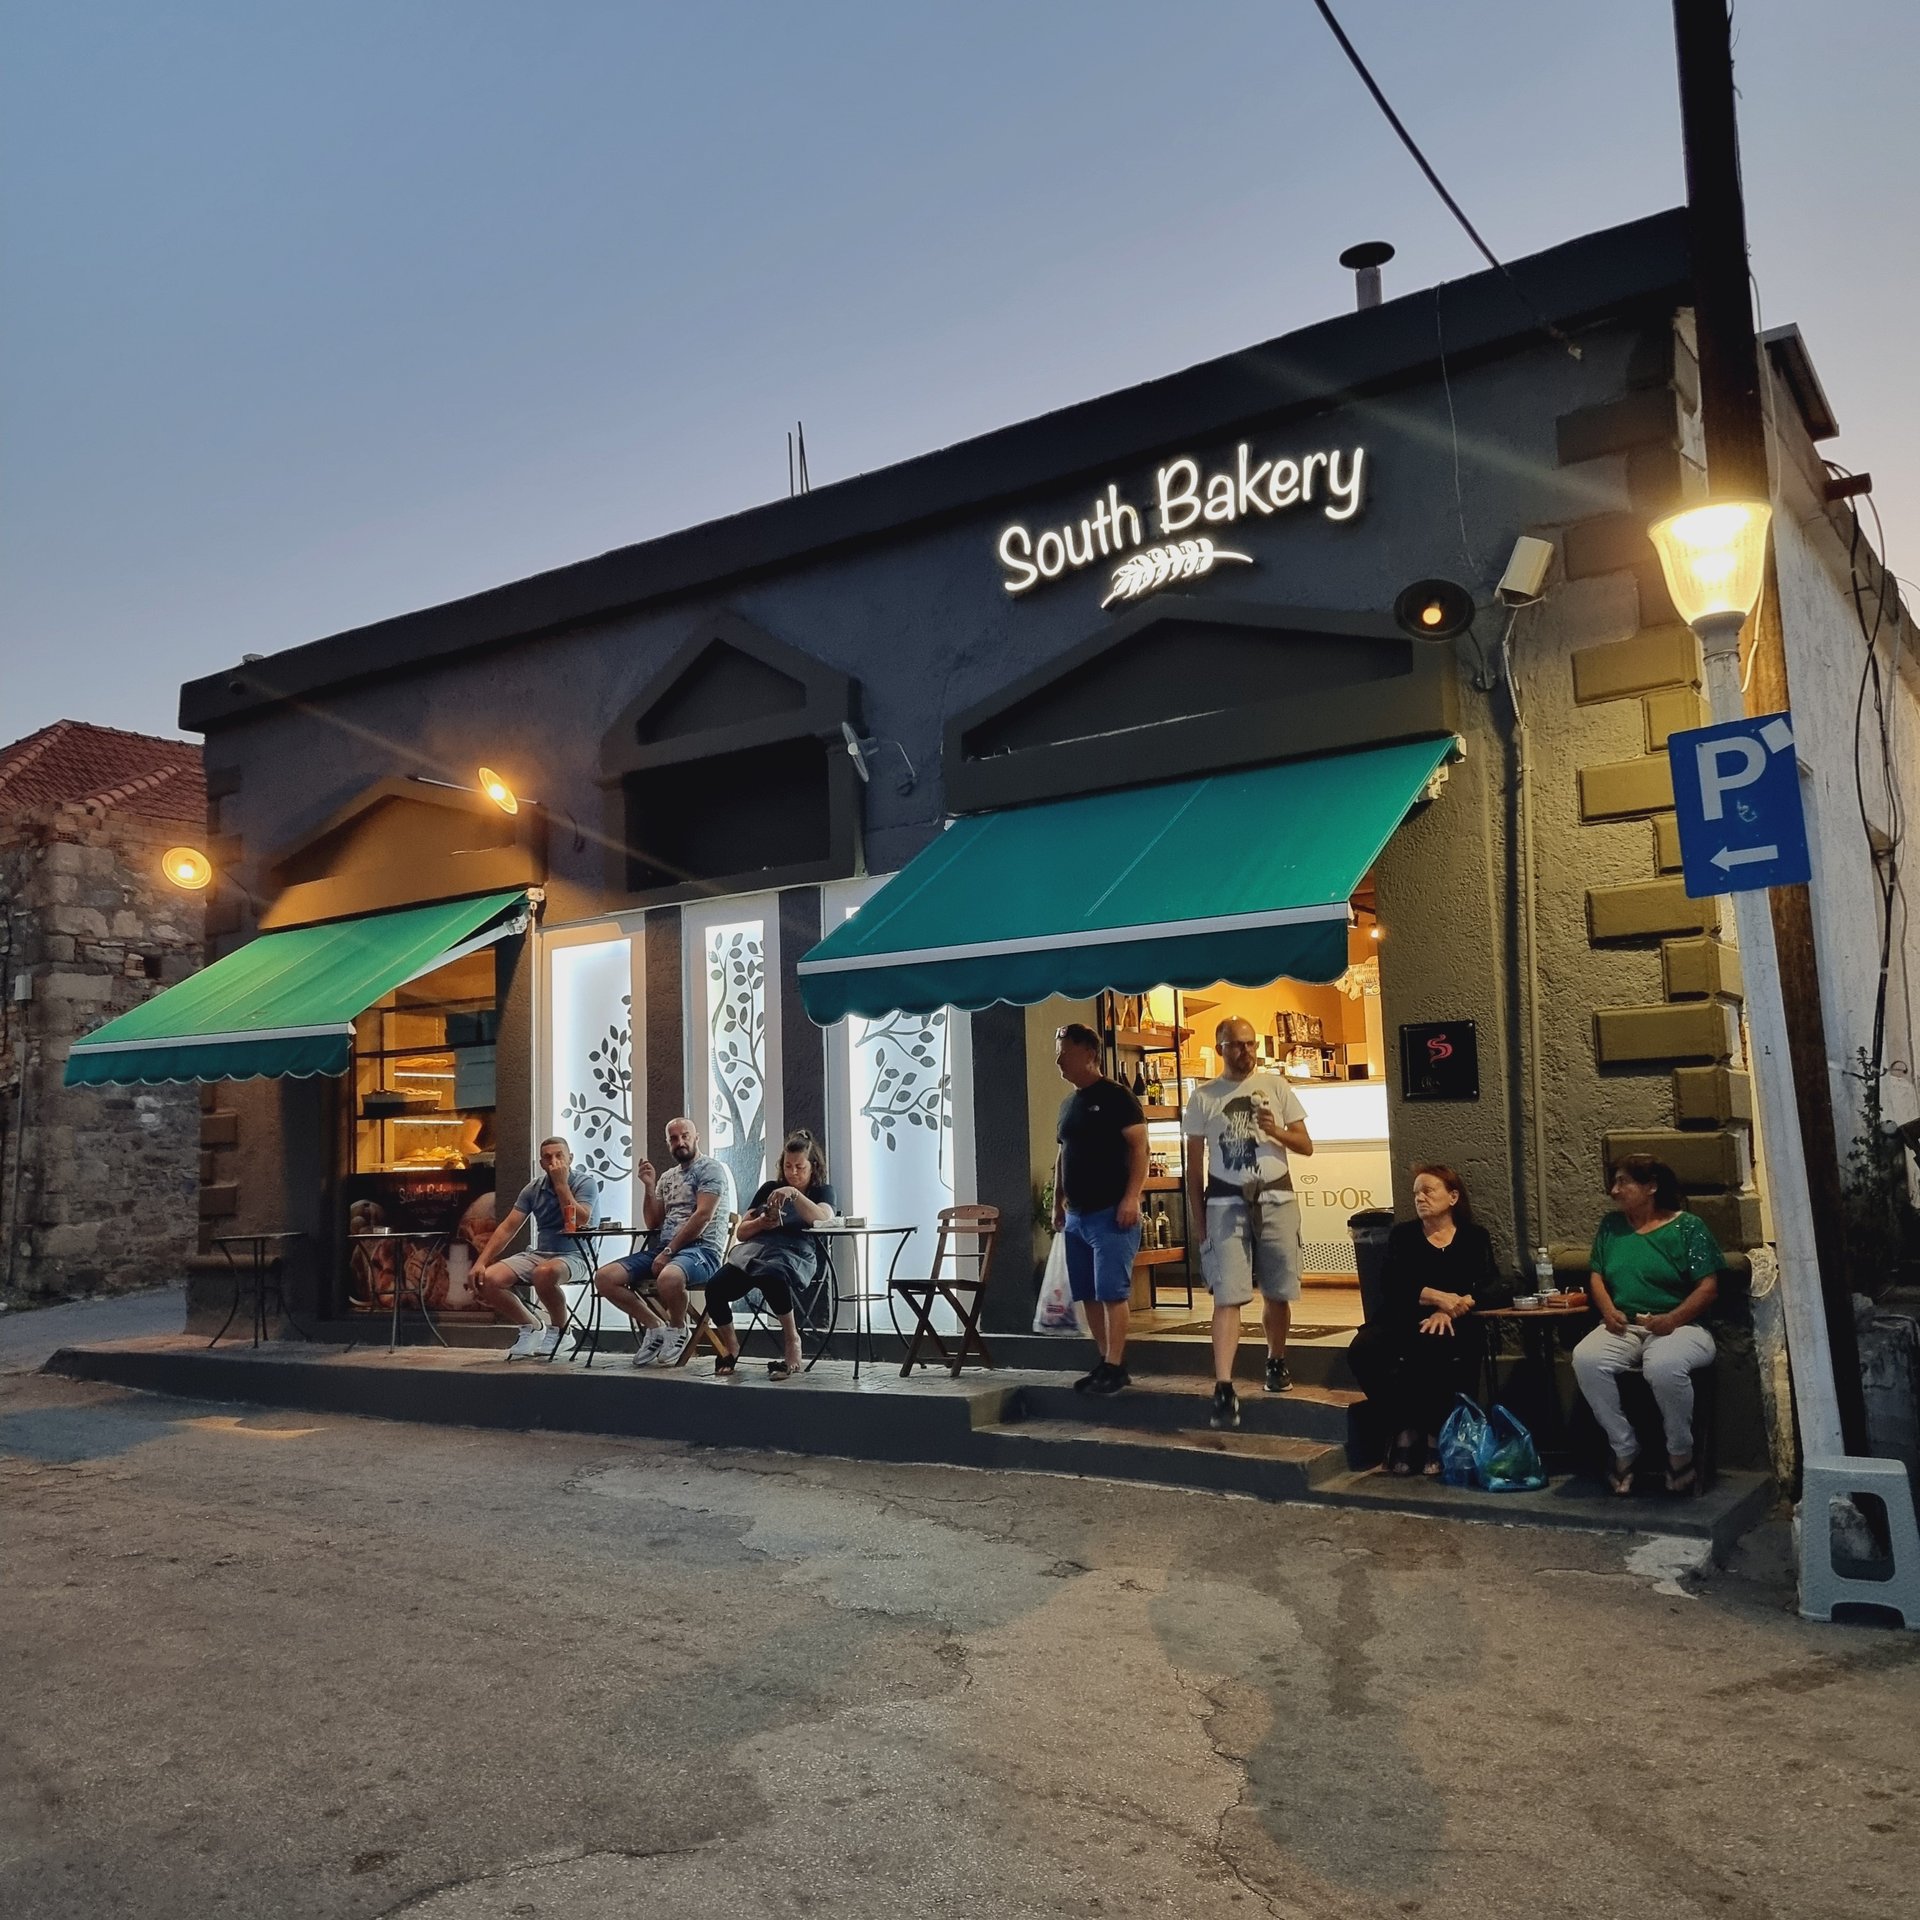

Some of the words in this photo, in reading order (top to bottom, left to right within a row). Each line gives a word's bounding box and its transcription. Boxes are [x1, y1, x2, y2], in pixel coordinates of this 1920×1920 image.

[999, 484, 1141, 592] South
[1157, 443, 1364, 521] Bakery
[1696, 736, 1767, 821] P
